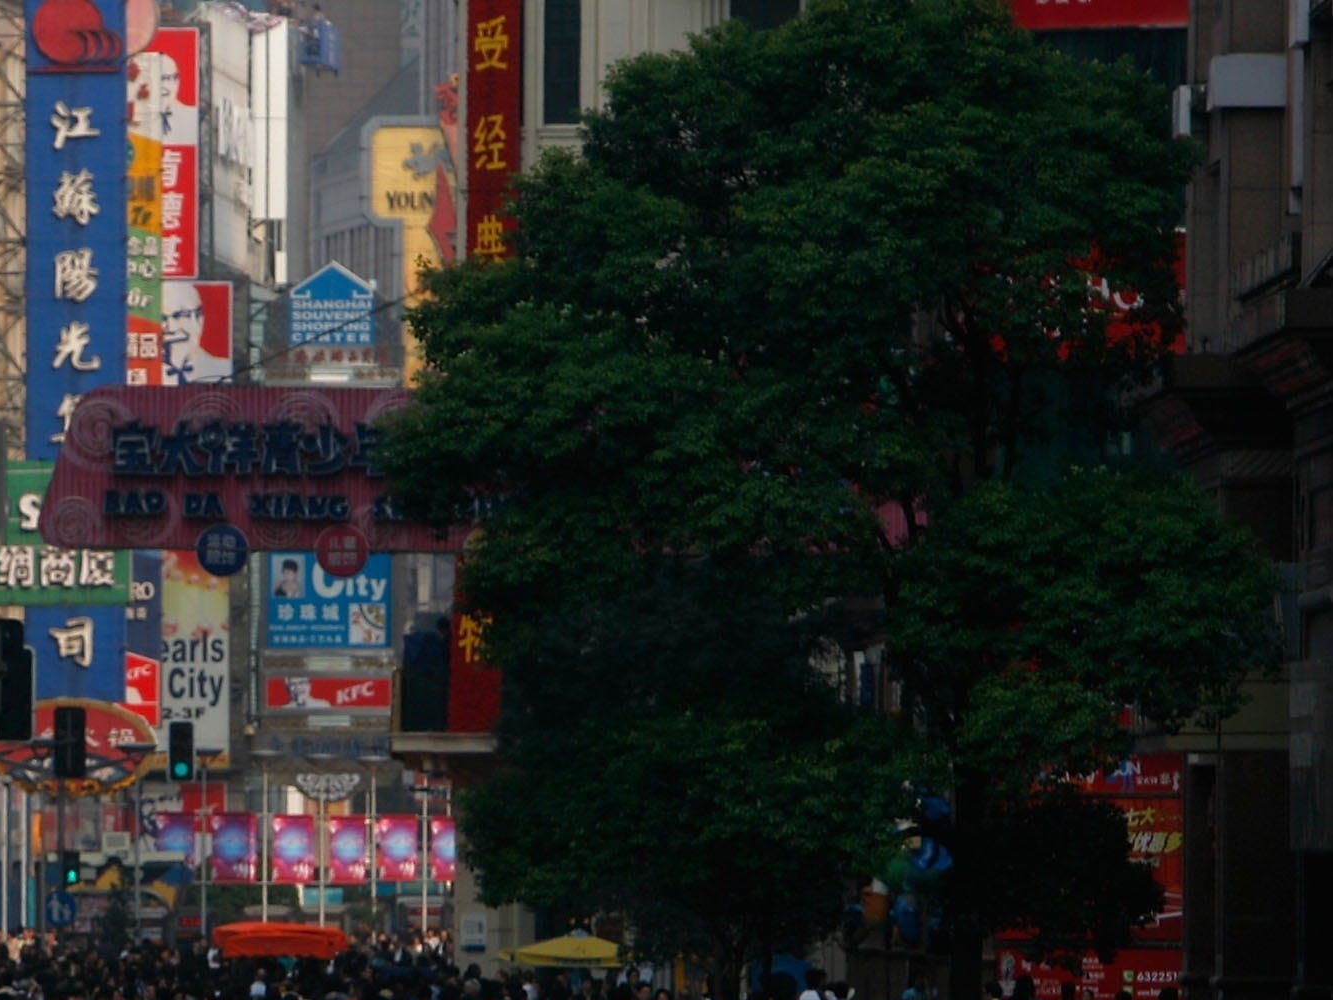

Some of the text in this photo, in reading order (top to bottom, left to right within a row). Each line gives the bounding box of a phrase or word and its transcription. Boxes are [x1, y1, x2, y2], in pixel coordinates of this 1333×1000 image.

[292, 299, 372, 309] SHANGHAI
[292, 310, 372, 321] SOUVENIR
[292, 321, 371, 332] SHOPPING
[291, 332, 371, 342] CENTER
[169, 667, 223, 706] City
[335, 681, 376, 704] KFC
